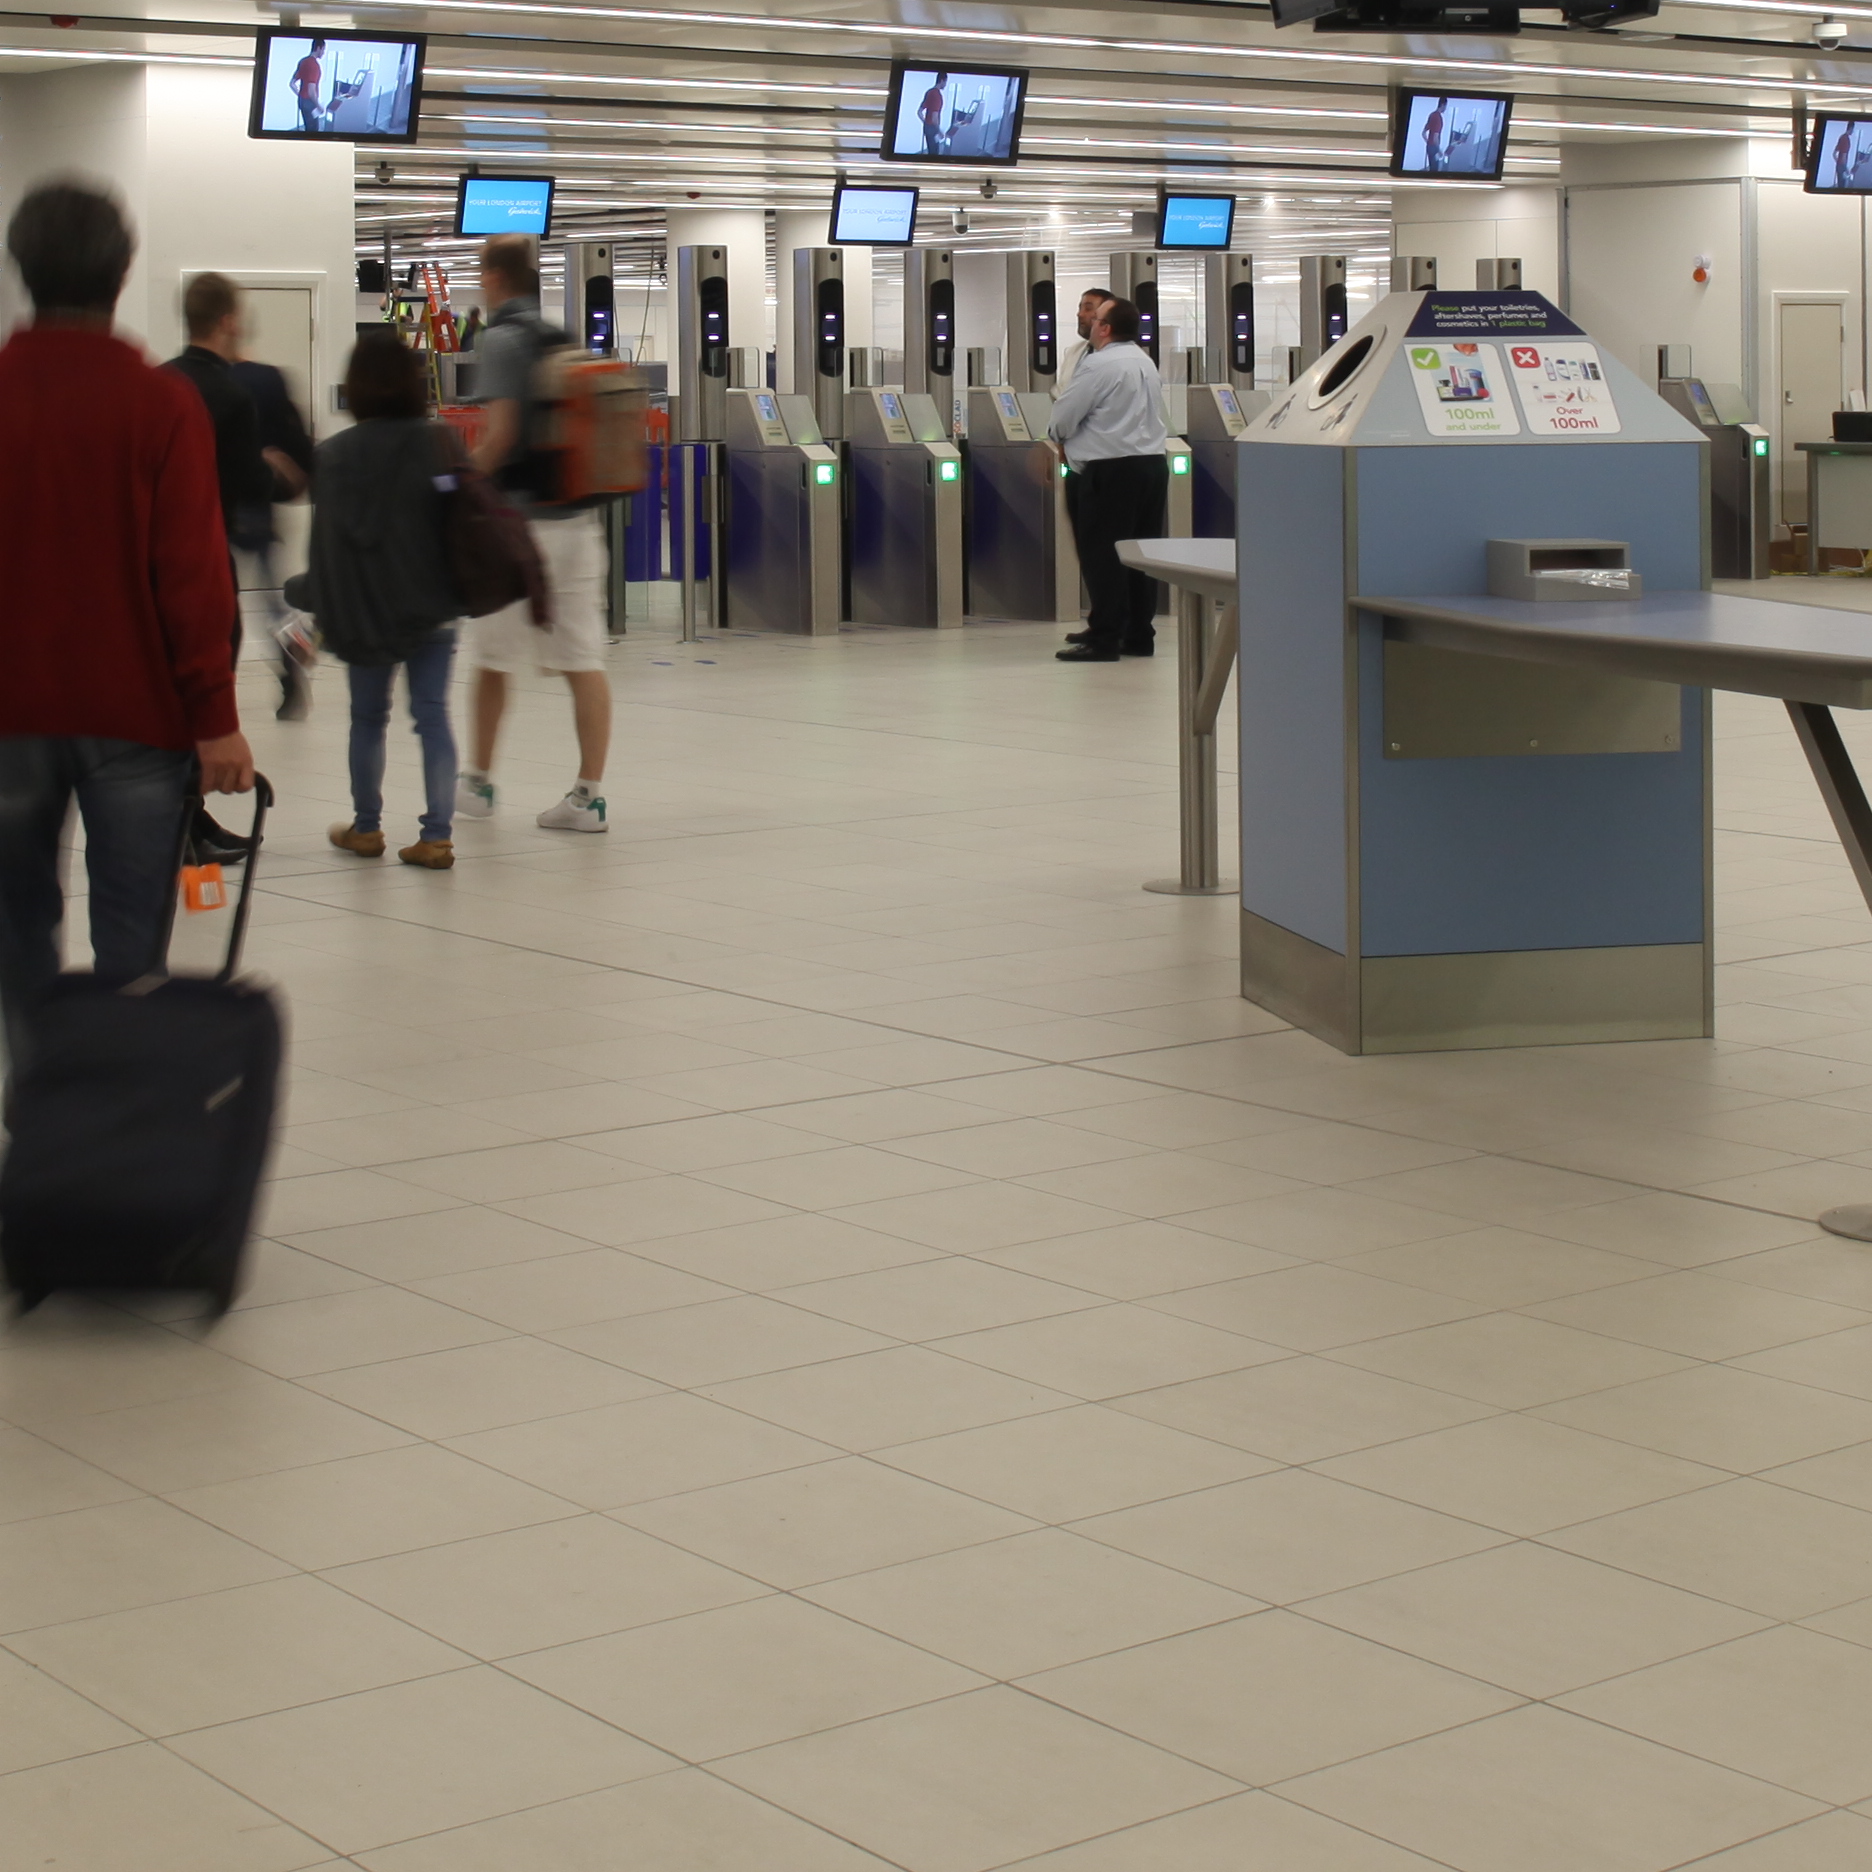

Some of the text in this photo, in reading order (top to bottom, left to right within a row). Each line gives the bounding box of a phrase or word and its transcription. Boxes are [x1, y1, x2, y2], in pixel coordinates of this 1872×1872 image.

[1488, 312, 1529, 320] perfumes
[1499, 320, 1526, 328] plastic
[1529, 320, 1546, 328] bag
[1446, 408, 1494, 420] 100ml
[1556, 406, 1583, 415] Over
[1446, 422, 1501, 431] and under
[1549, 416, 1599, 429] 100ml
